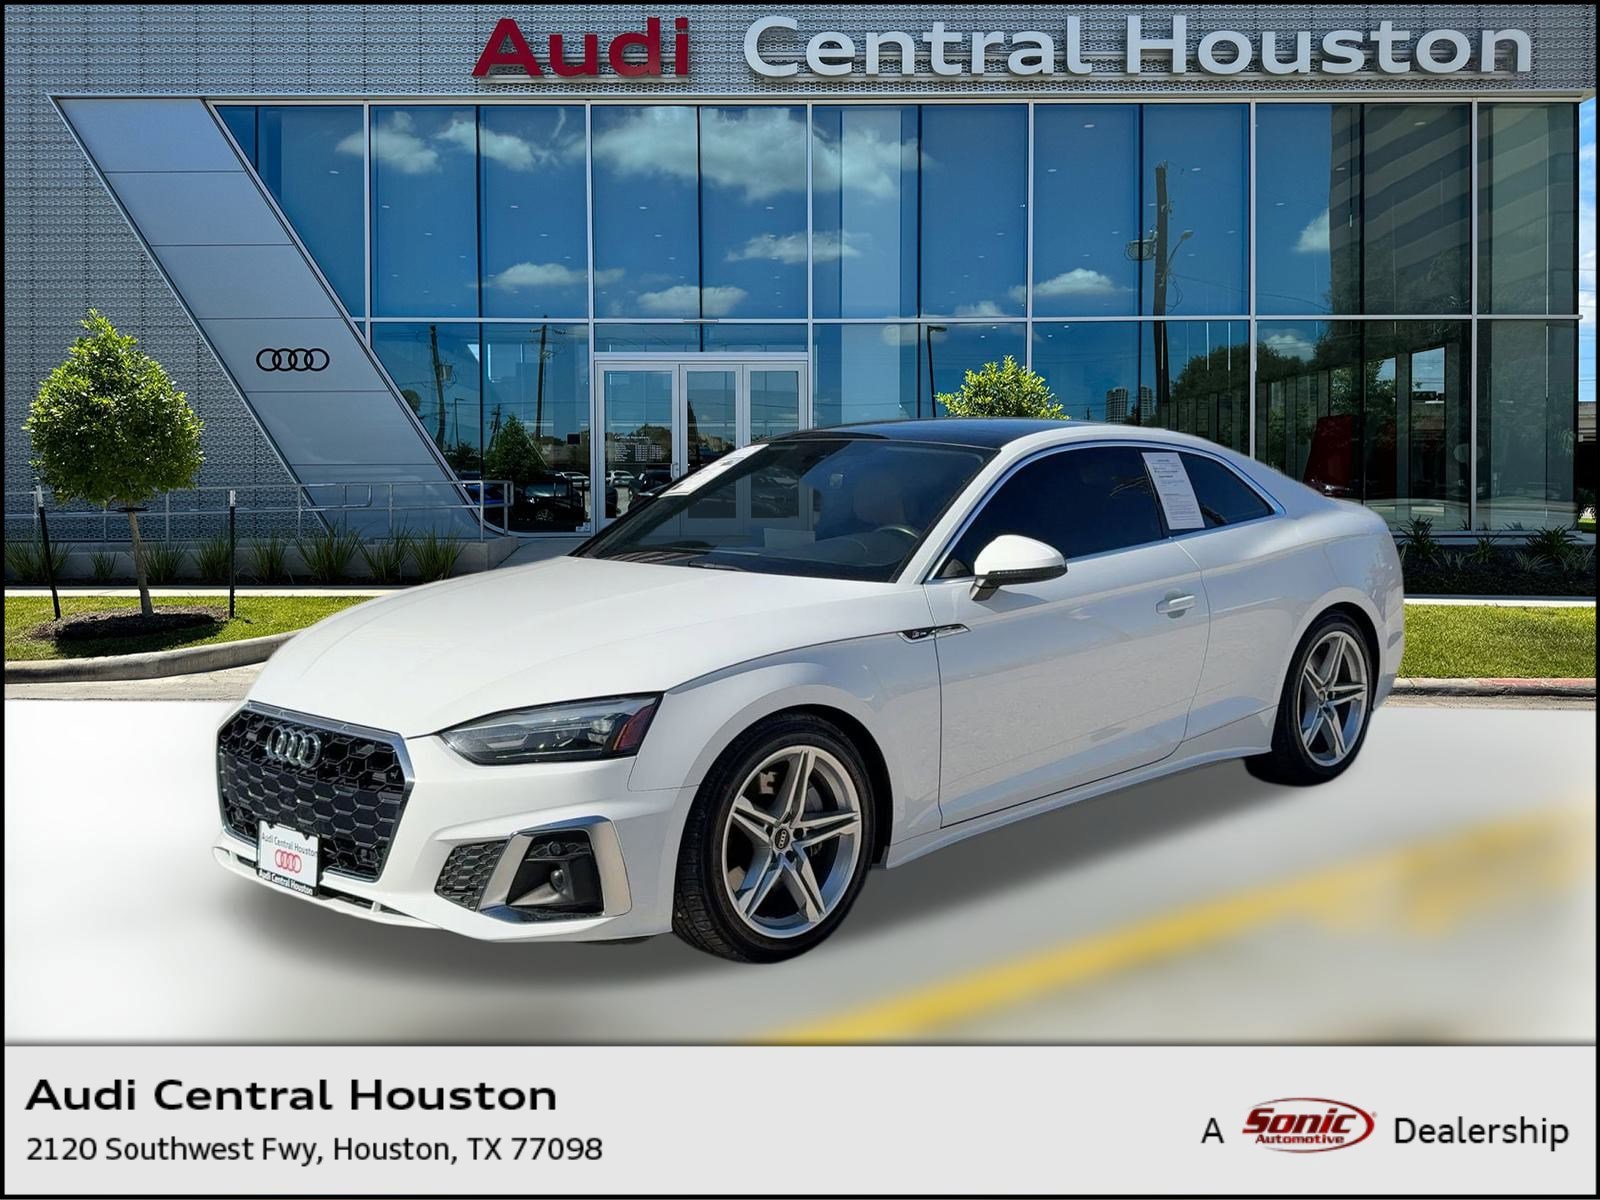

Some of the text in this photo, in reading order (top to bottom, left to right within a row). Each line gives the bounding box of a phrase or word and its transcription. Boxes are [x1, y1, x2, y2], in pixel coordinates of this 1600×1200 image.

[472, 15, 1531, 77] Audi Central Houston
[274, 836, 294, 850] Central
[271, 873, 291, 888] Central
[290, 878, 314, 896] Houston
